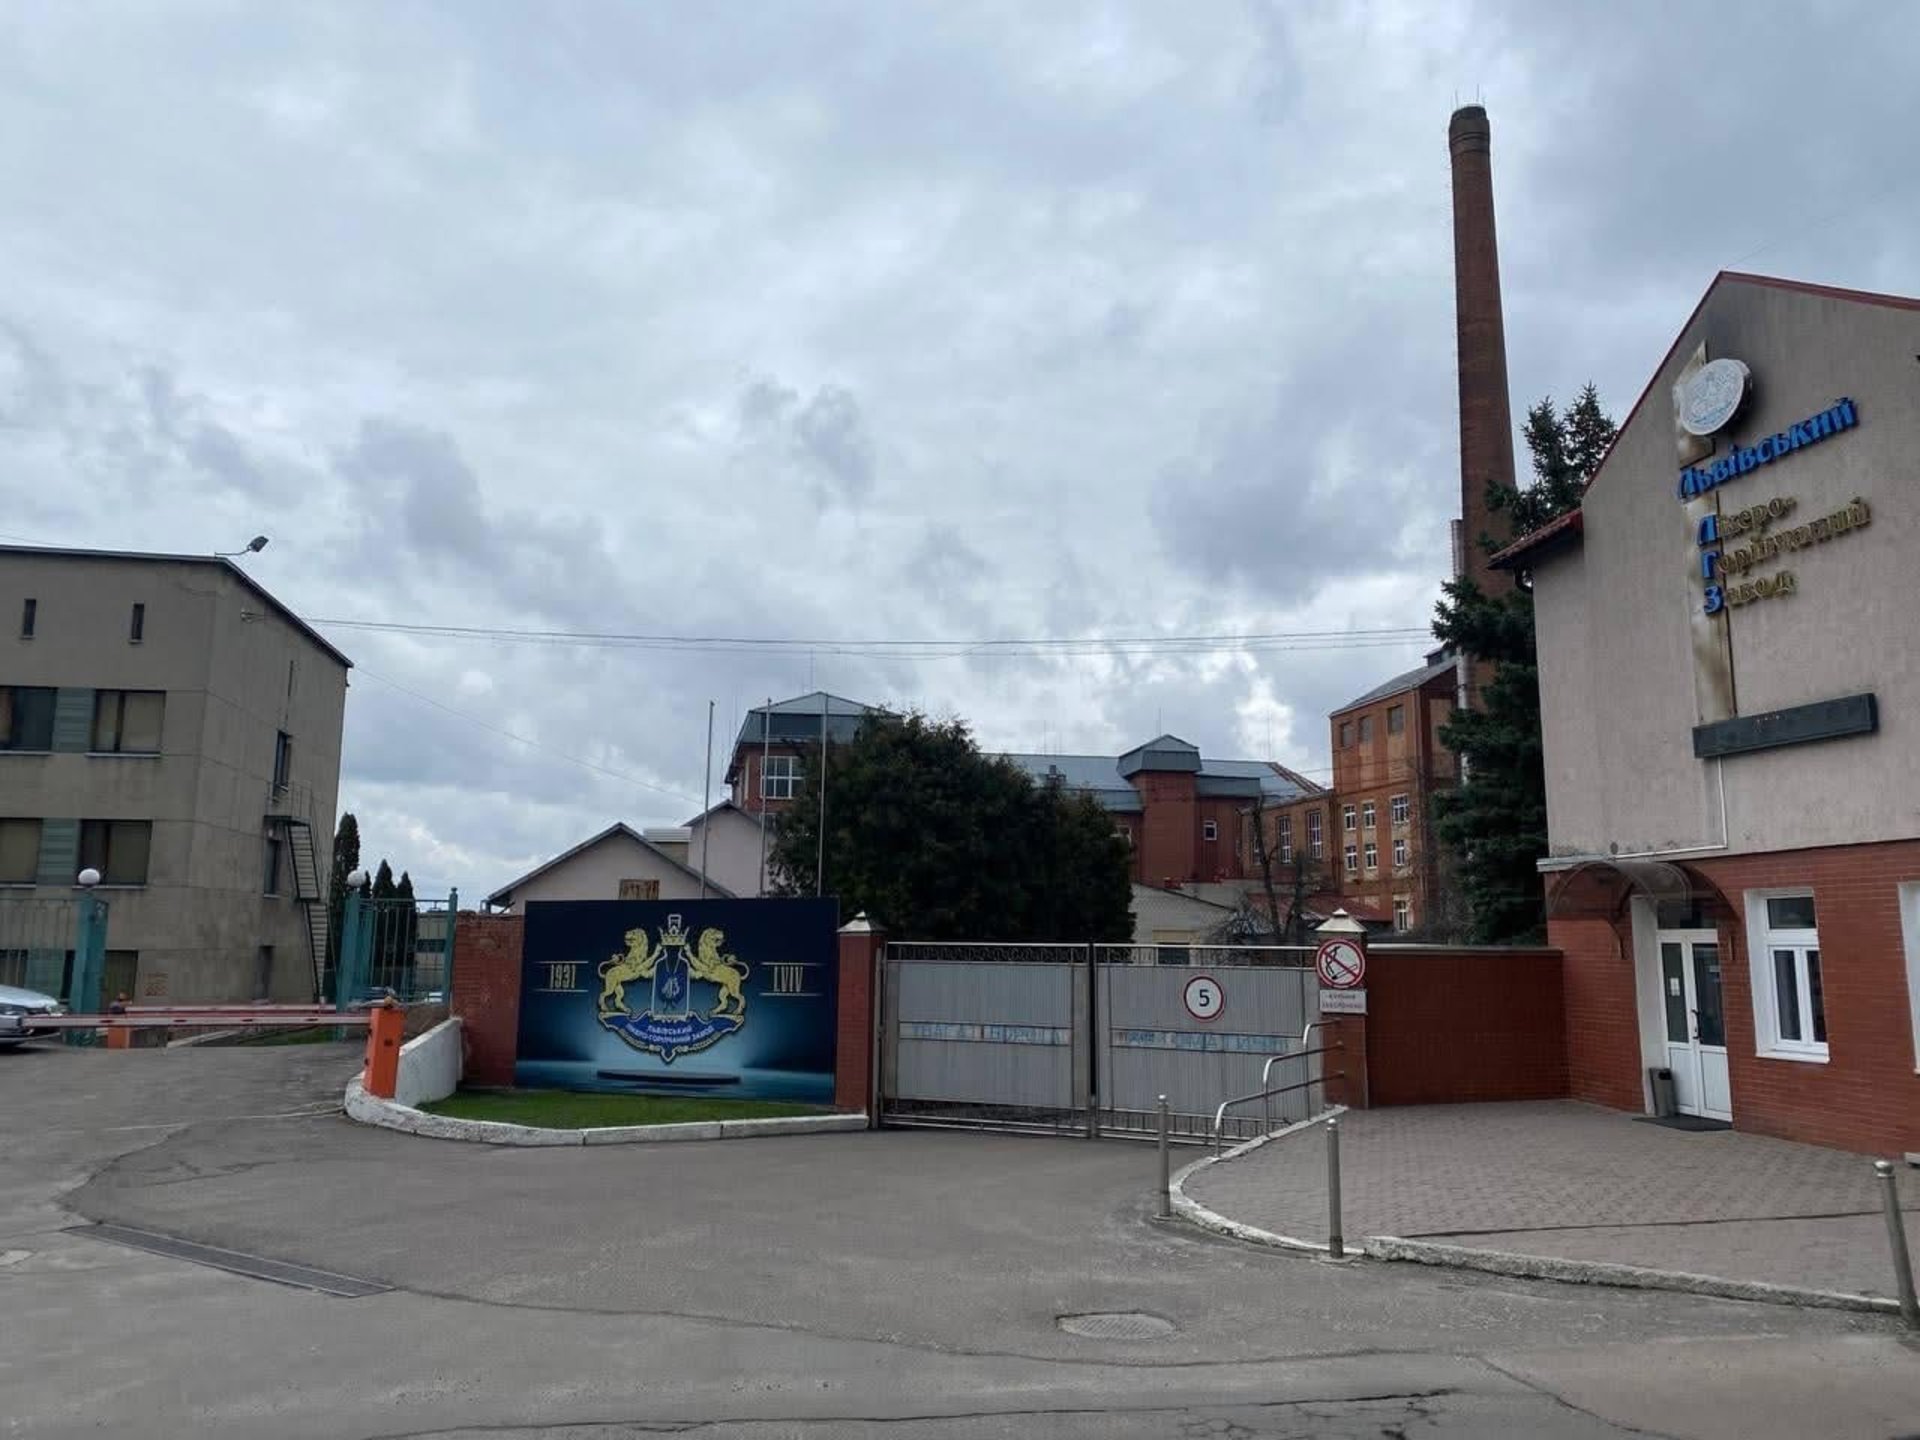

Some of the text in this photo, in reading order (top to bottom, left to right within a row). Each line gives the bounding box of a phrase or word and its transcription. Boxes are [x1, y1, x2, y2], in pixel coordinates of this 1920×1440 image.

[1679, 397, 1859, 500] Львівський
[550, 963, 577, 989] 1931
[773, 965, 804, 992] LVIV
[1199, 989, 1210, 1007] 5
